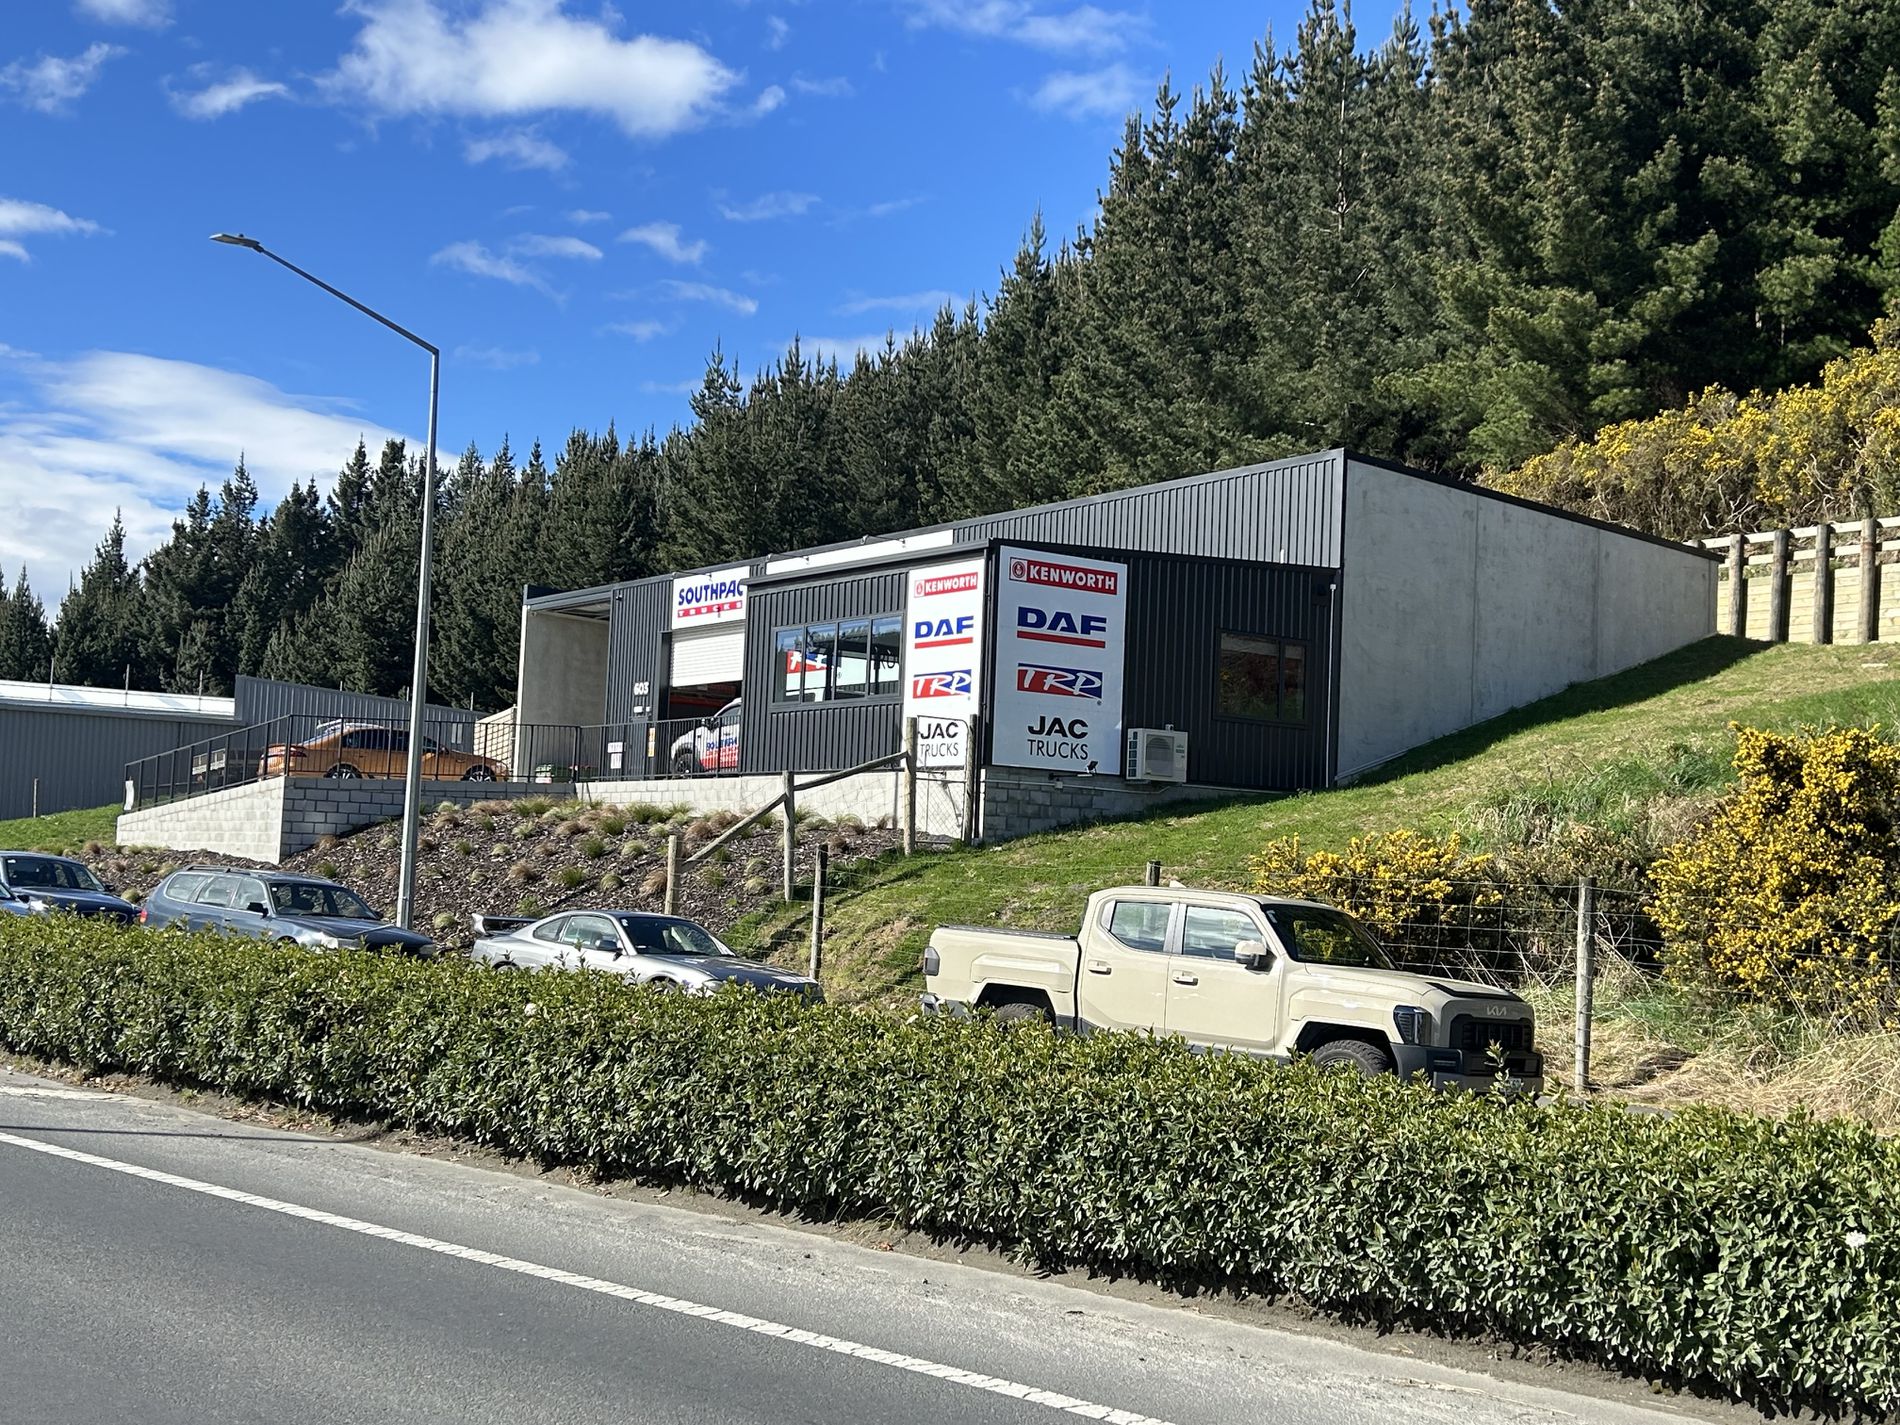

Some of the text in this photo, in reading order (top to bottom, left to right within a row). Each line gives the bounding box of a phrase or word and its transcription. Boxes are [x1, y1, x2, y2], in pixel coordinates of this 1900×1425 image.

[925, 574, 977, 594] KENWORTH
[1029, 564, 1115, 590] KENWORTH
[678, 580, 743, 606] SOUTHPAC
[678, 601, 742, 617] TRUCKS
[1017, 606, 1107, 635] DAF
[915, 615, 974, 639] DAF
[634, 681, 650, 696] 603
[913, 670, 971, 698] TRP
[1018, 665, 1102, 699] TRP
[920, 721, 959, 740] JAC
[1027, 715, 1089, 740] JAC
[920, 742, 959, 758] TRUCKS
[1027, 739, 1089, 761] TRUCKS
[1487, 1006, 1507, 1016] KIA
